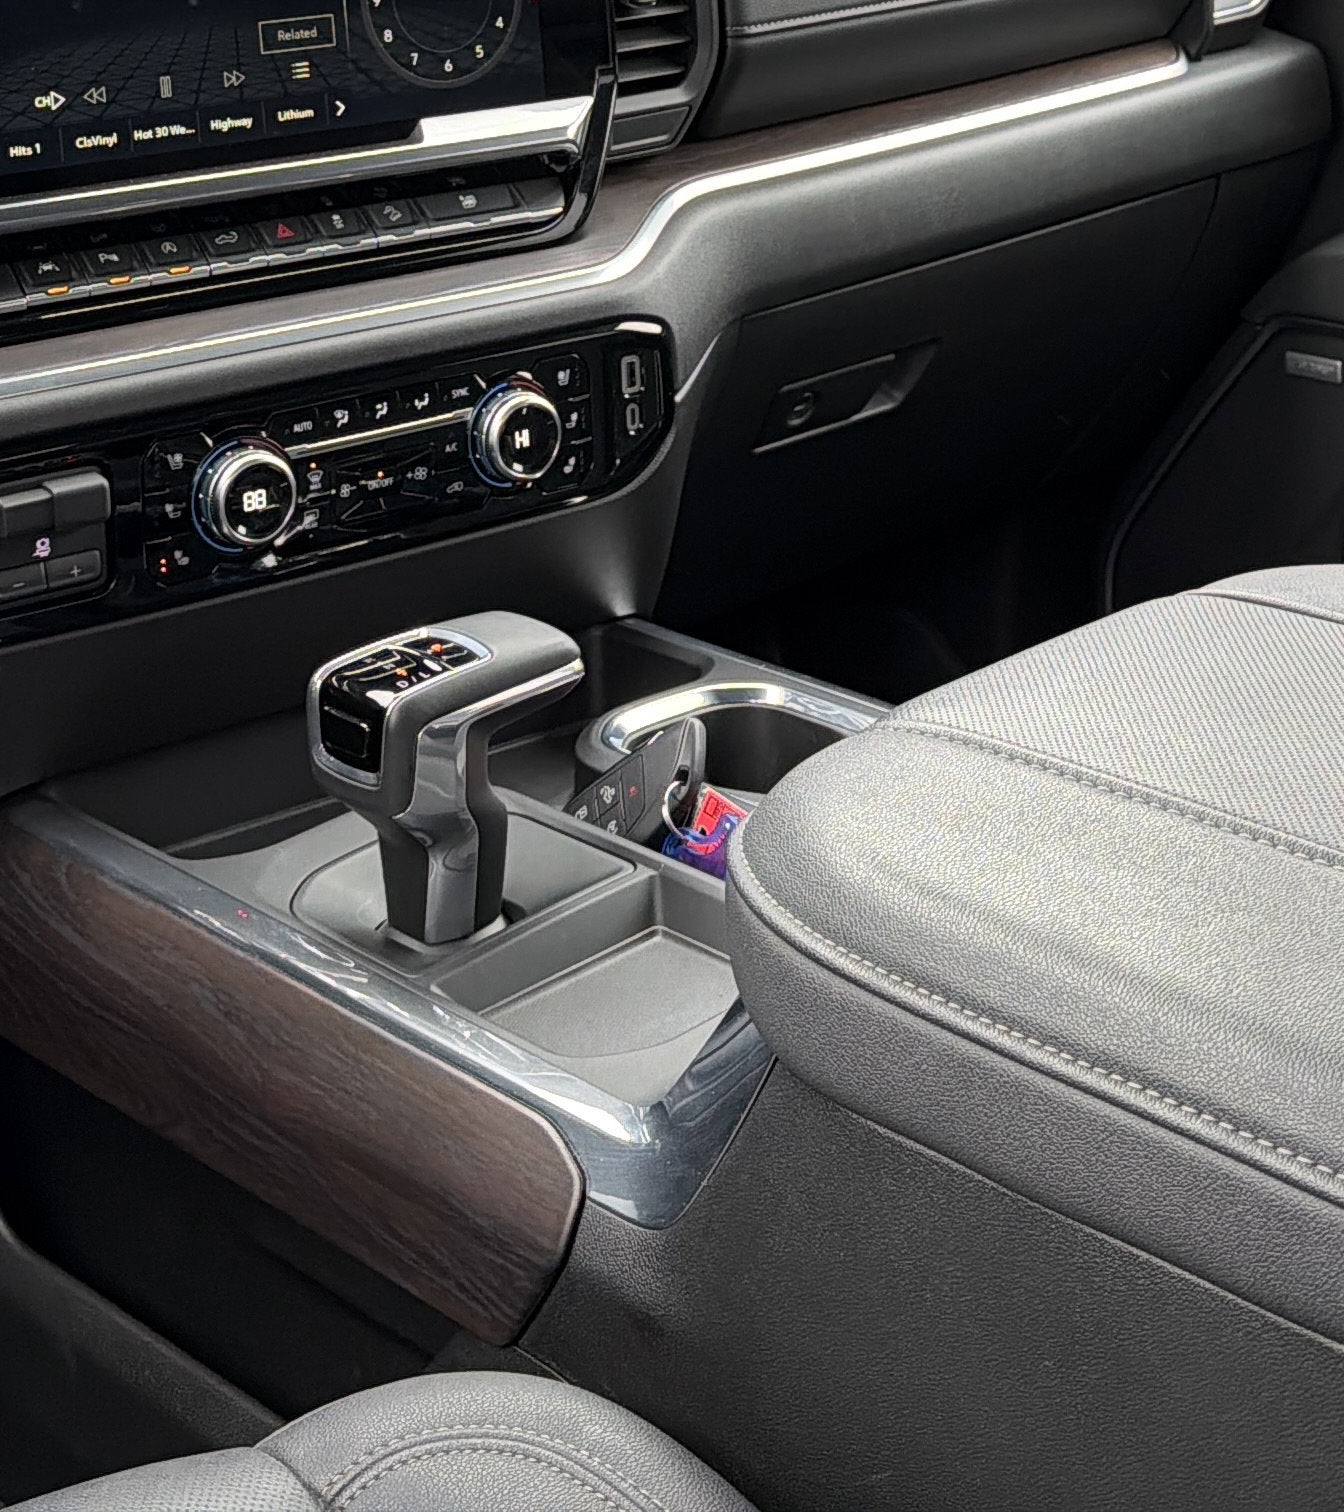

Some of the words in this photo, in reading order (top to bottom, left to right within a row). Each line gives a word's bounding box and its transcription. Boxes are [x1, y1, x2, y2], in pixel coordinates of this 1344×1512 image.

[495, 16, 504, 29] 4
[277, 25, 318, 42] Related
[383, 29, 393, 43] 8
[474, 44, 485, 59] 5
[409, 52, 419, 66] 7
[443, 58, 454, 73] 6
[34, 95, 52, 108] CH
[277, 108, 315, 122] Lithium
[210, 116, 253, 133] Highway
[133, 129, 153, 141] Hot
[155, 125, 169, 138] 30
[9, 145, 33, 158] Hits
[451, 387, 471, 399] SYNC
[293, 420, 313, 433] AUTO
[514, 428, 531, 450] HI
[367, 477, 395, 490] ON/OFF
